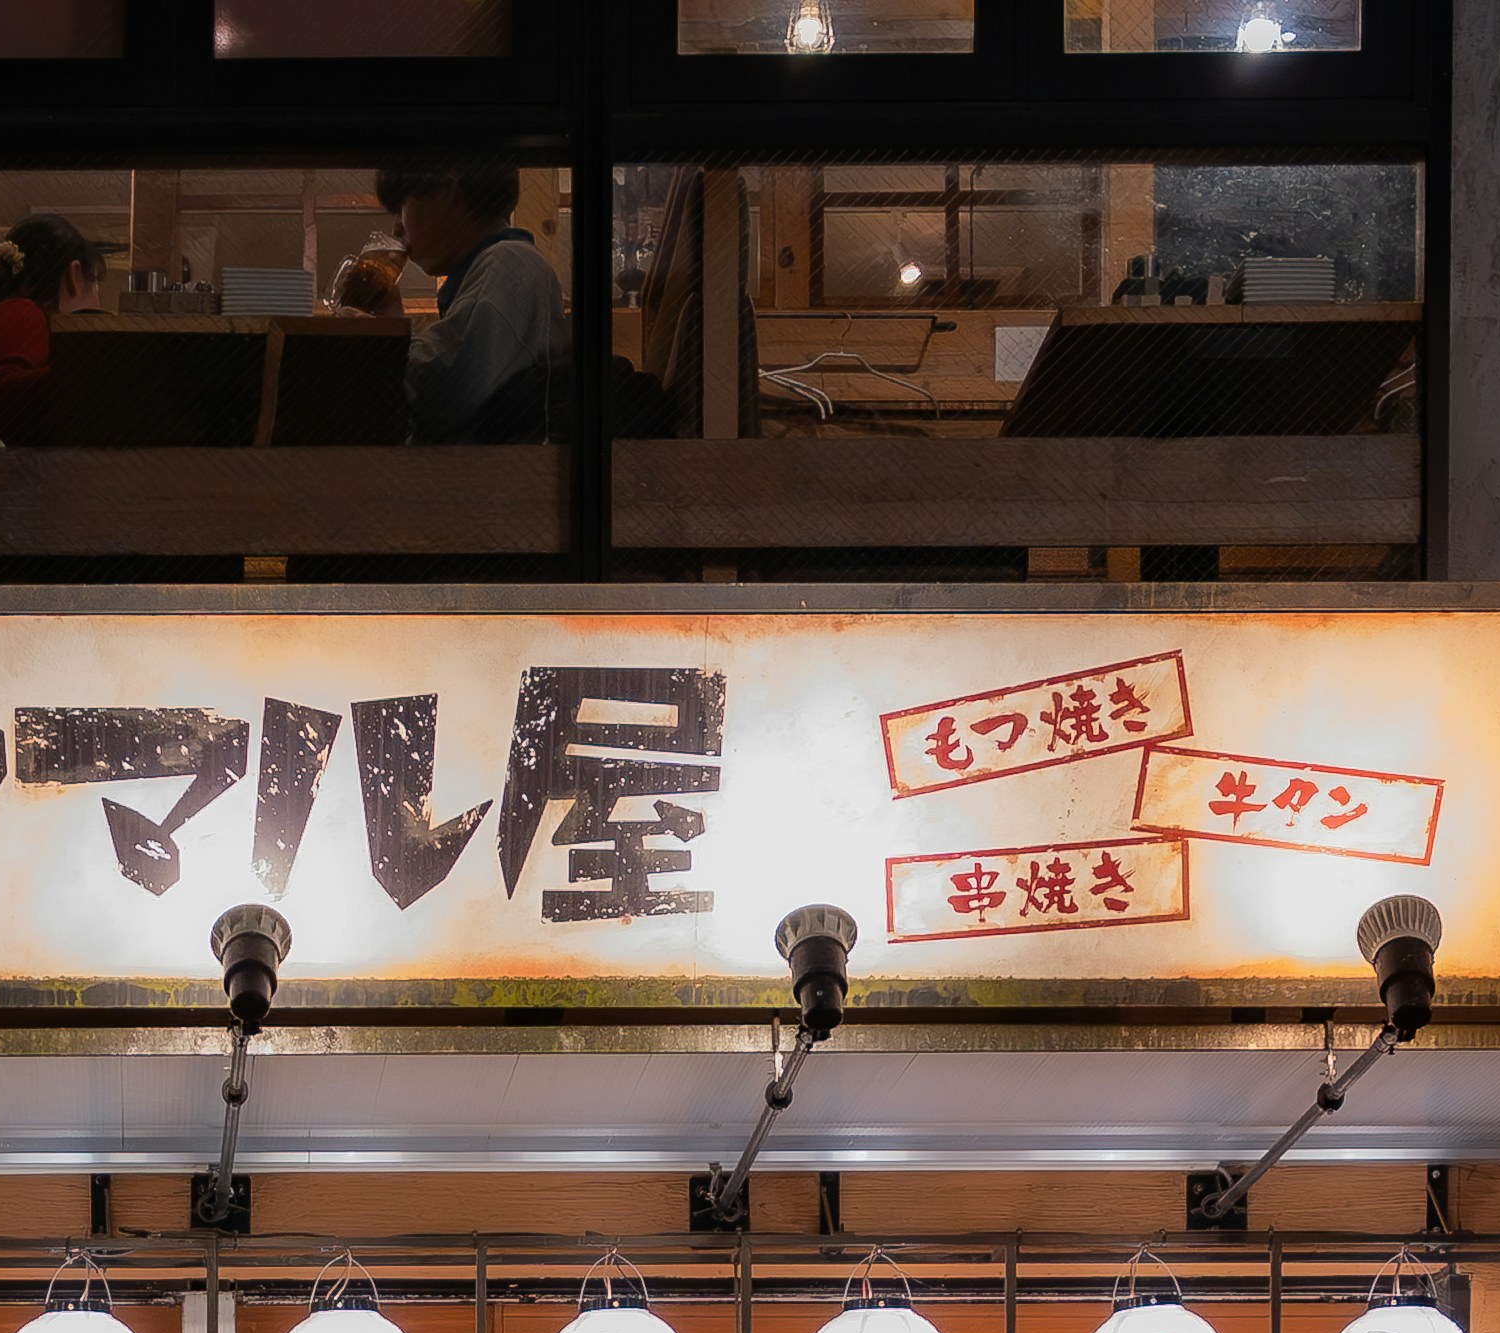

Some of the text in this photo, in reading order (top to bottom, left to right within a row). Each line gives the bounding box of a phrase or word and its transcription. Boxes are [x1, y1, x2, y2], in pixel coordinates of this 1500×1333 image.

[923, 675, 1151, 773] もつ焼き
[1206, 769, 1371, 832] 牛タン
[948, 849, 1137, 923] 串焼き
